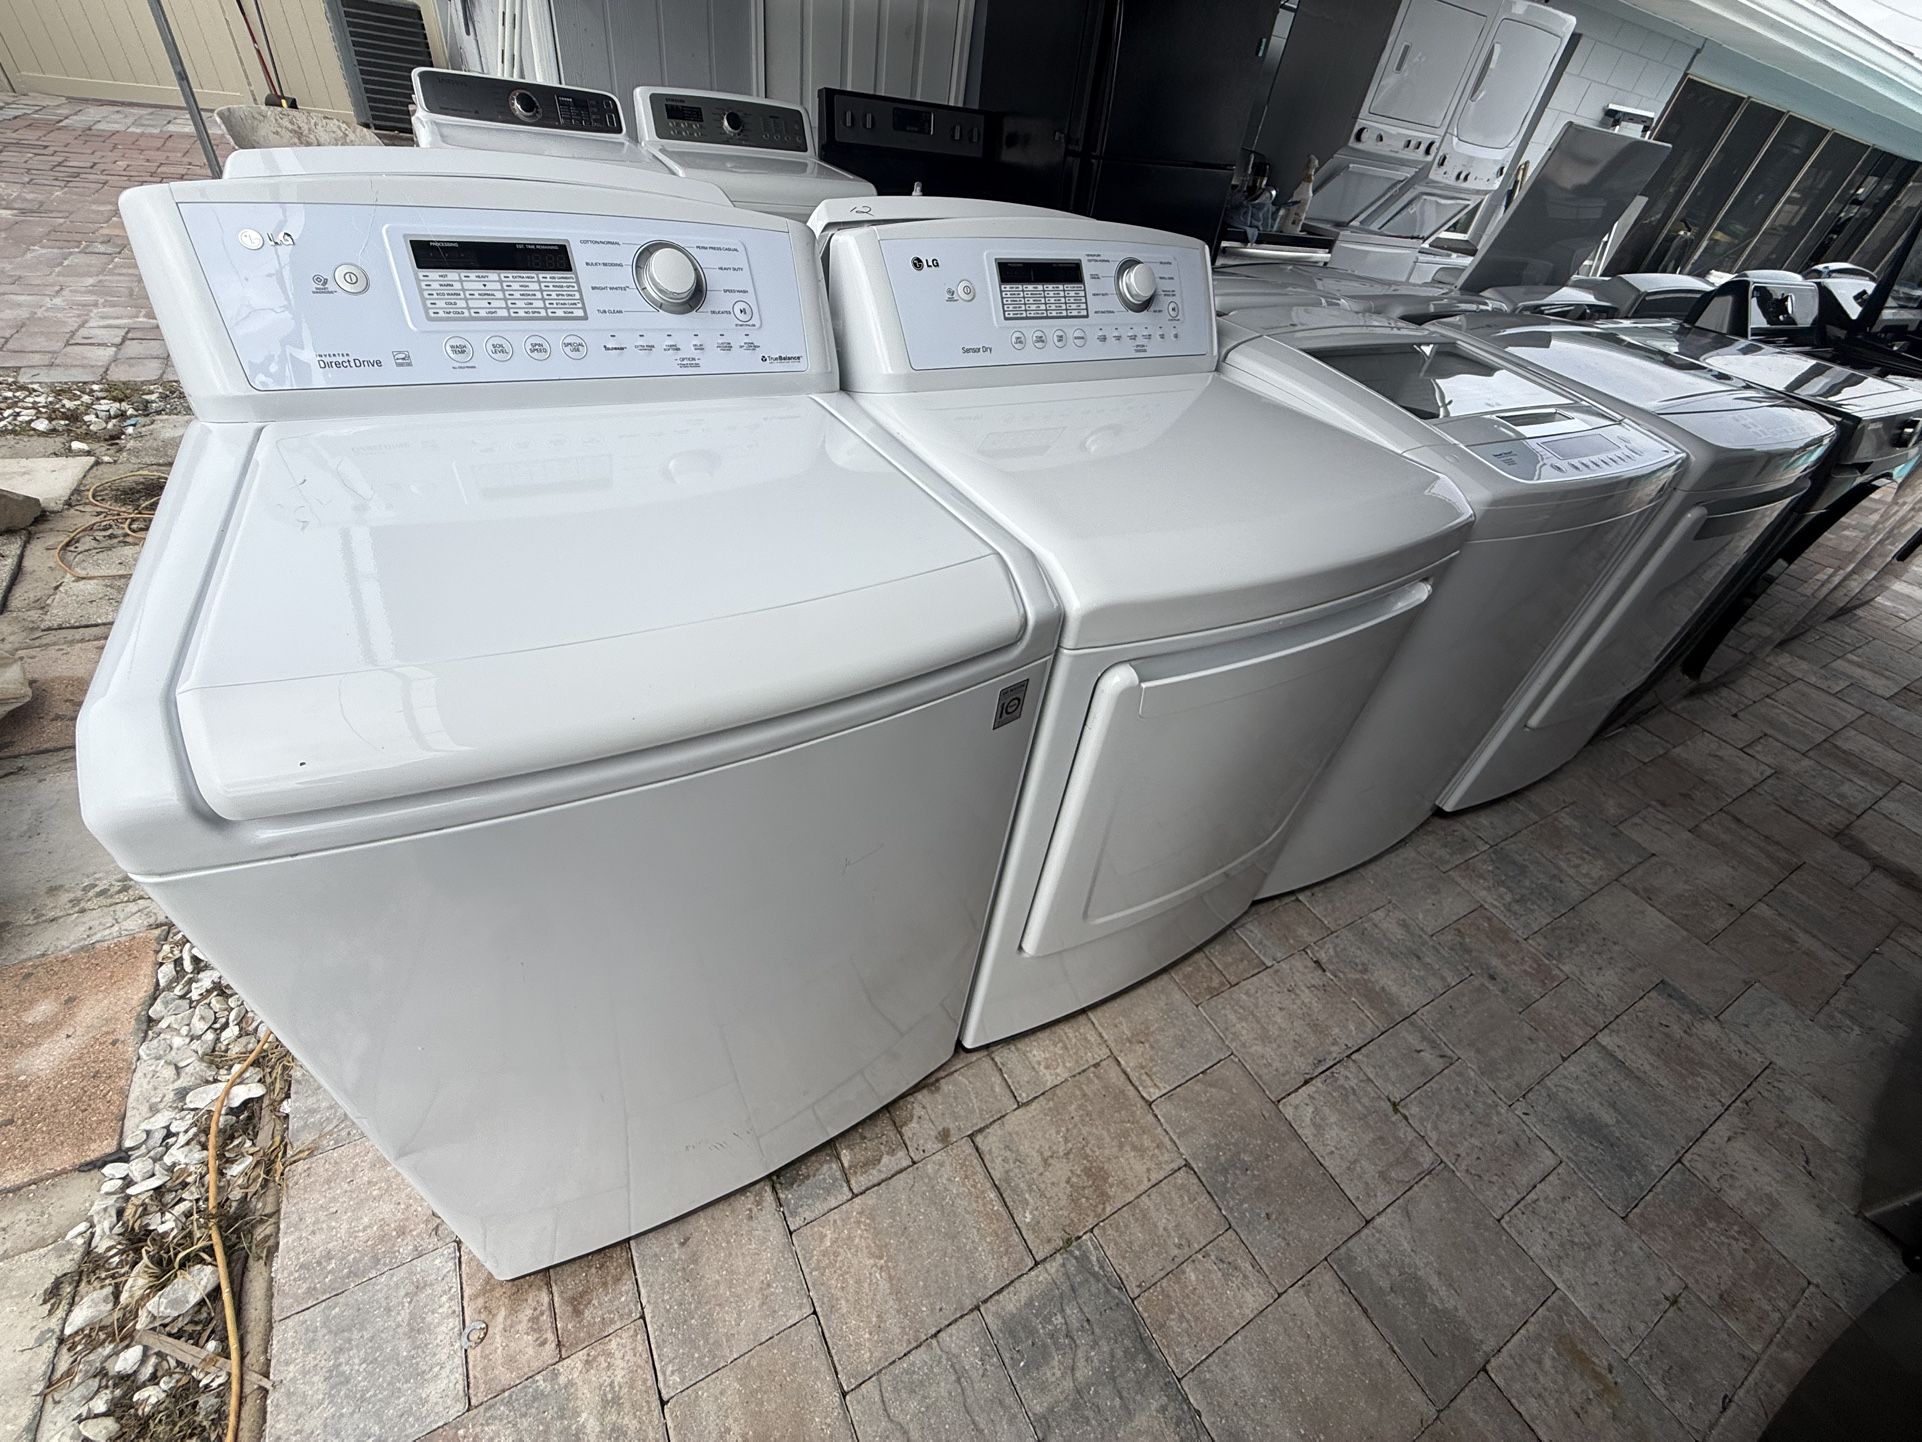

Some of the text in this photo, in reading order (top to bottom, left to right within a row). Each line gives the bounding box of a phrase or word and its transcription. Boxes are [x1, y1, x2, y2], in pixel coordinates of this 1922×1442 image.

[925, 257, 940, 268] LG
[961, 346, 993, 354] Sensor Dry
[317, 358, 353, 369] Direct
[353, 358, 383, 369] Drive
